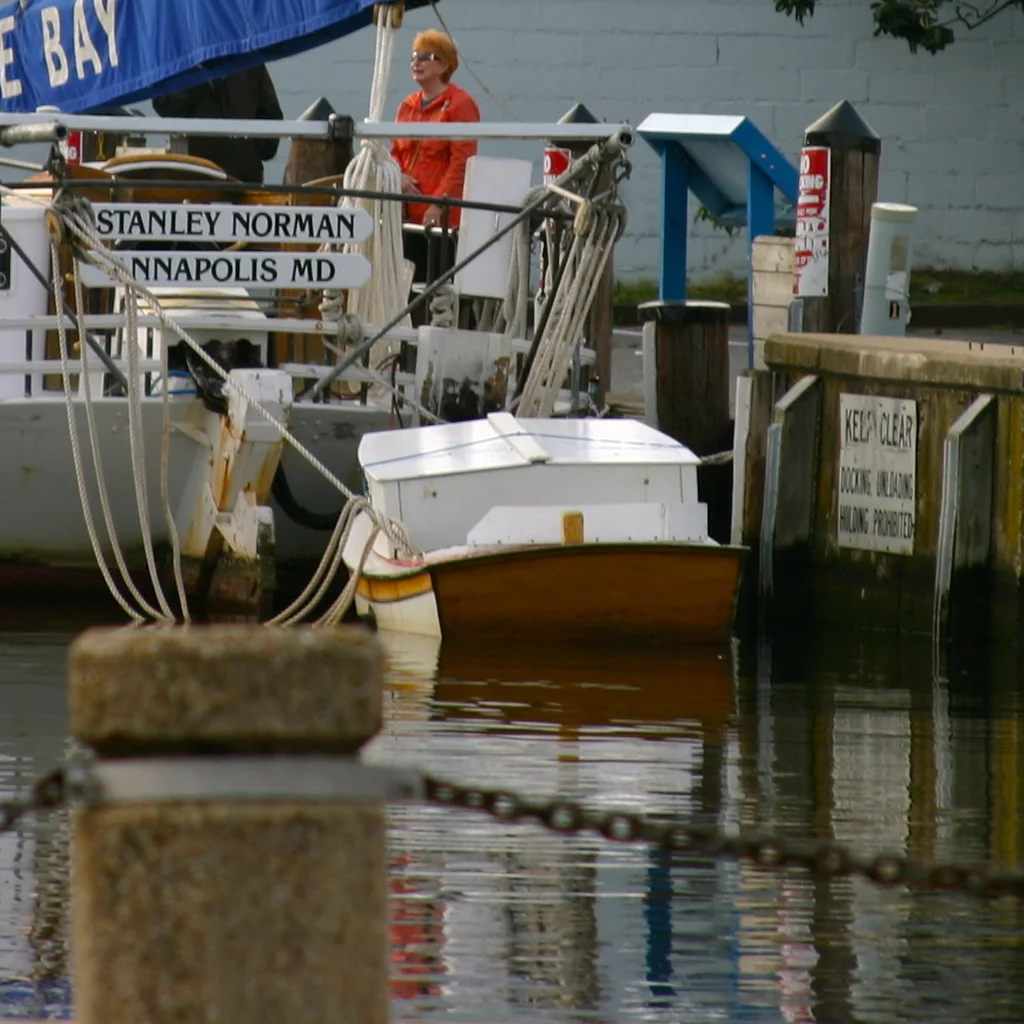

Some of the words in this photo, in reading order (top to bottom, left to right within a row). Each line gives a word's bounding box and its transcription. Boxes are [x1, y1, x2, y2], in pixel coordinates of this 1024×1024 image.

[96, 209, 221, 236] STANLEY
[232, 211, 356, 239] NORMAN
[110, 257, 278, 283] NNAPOLIS
[291, 258, 336, 283] MD
[879, 412, 912, 448] CLEAR
[873, 508, 913, 539] PROHIBITED
